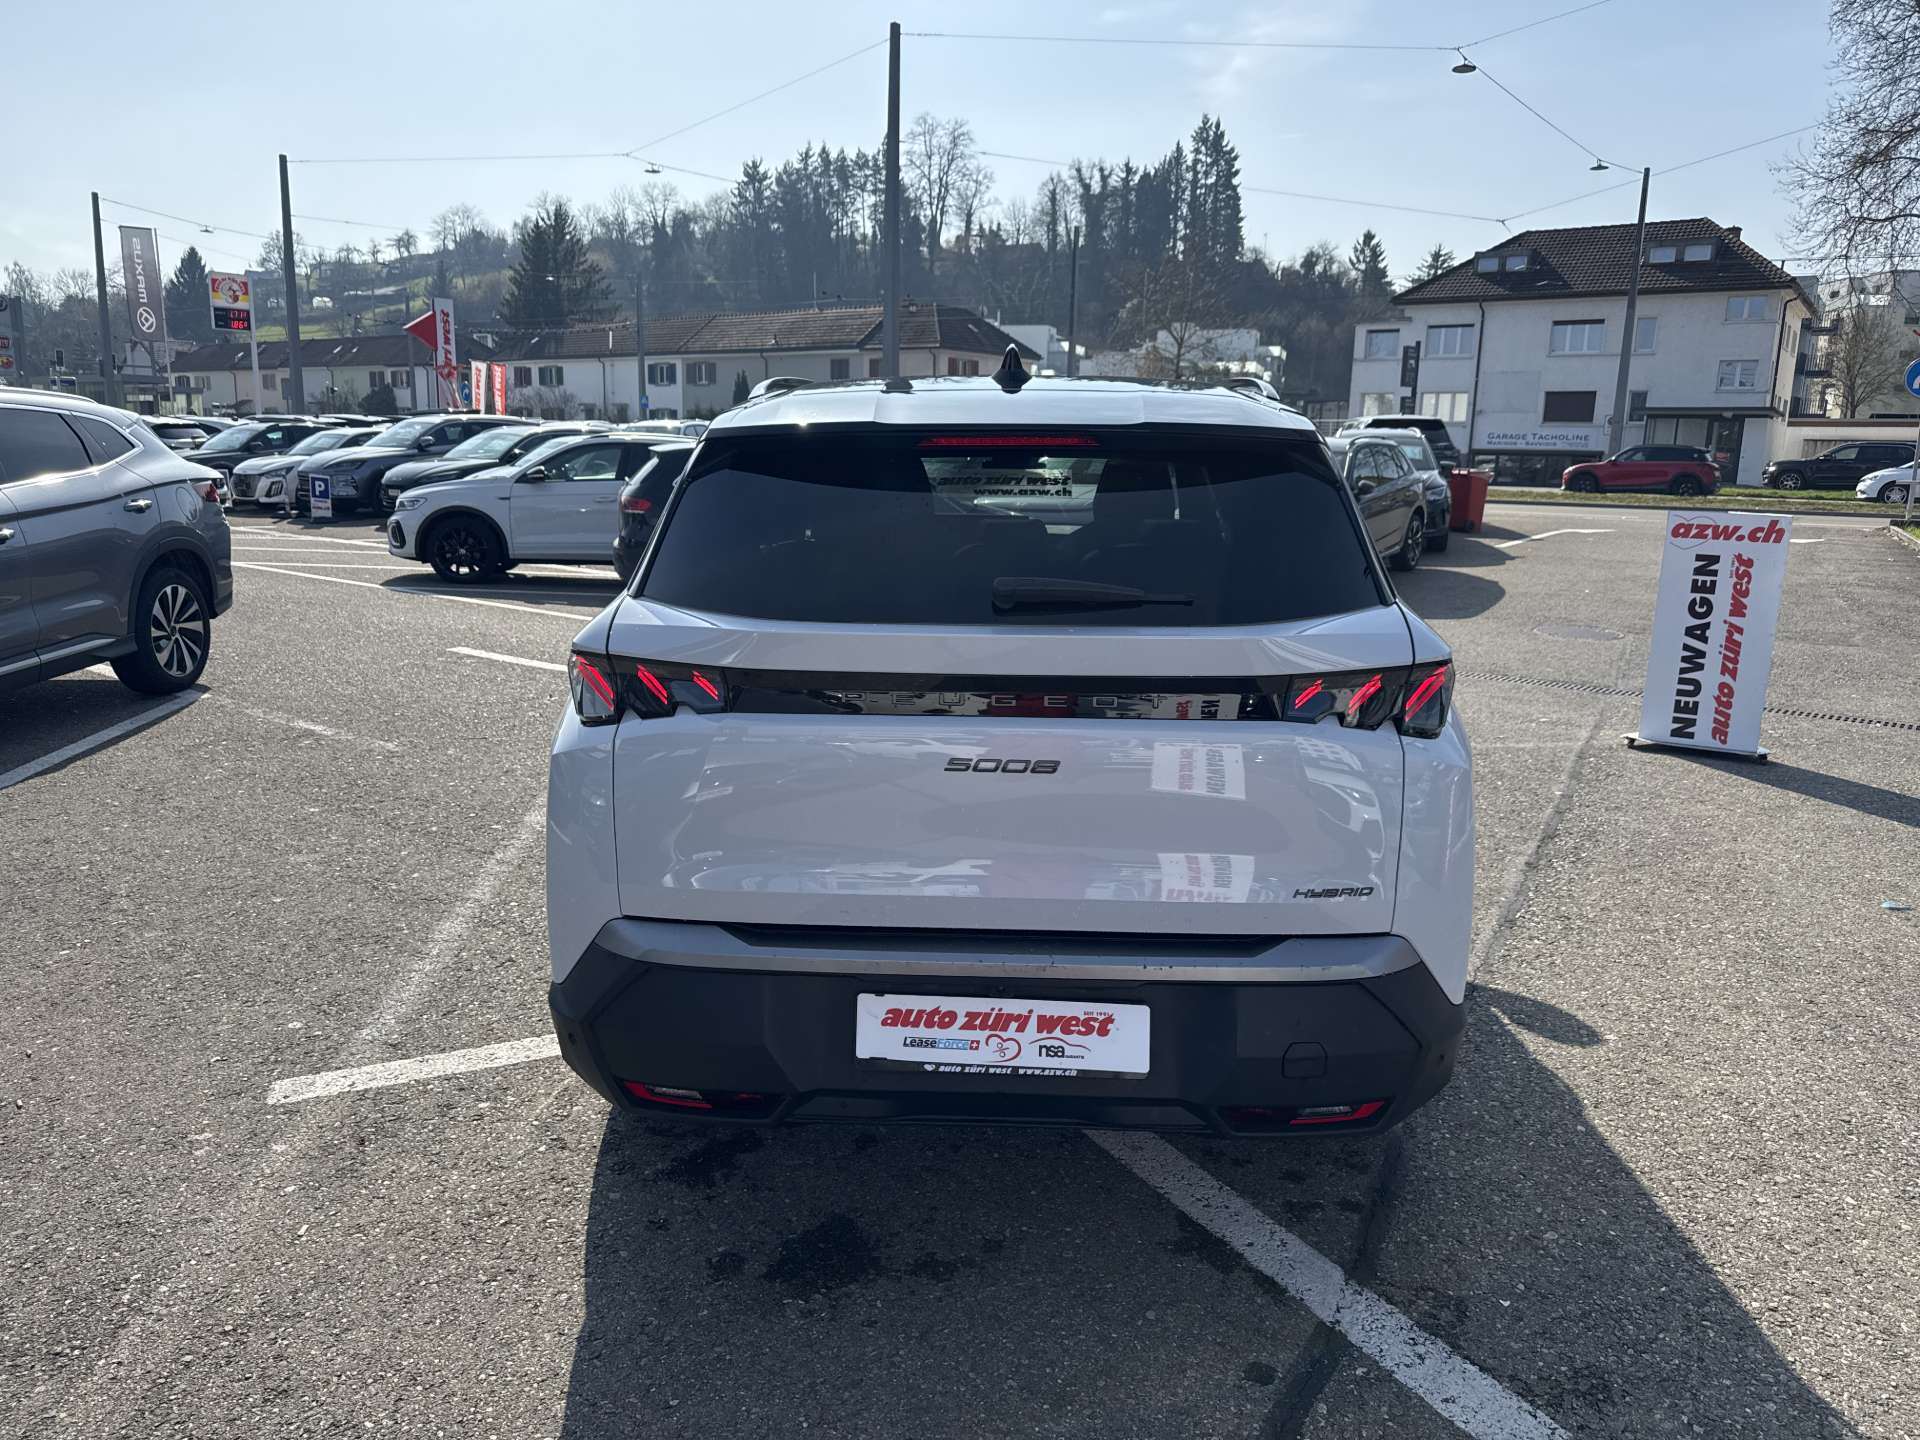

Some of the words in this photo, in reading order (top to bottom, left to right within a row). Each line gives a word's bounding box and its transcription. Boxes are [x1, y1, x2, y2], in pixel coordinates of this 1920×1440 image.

[1671, 520, 1786, 544] azw.ch
[1728, 552, 1755, 618] west
[1670, 553, 1721, 740] NEUWAGEN
[1718, 619, 1745, 682] züri
[1711, 681, 1735, 745] auto
[943, 757, 1061, 775] 5008
[1292, 886, 1375, 899] HYBRID
[880, 1004, 957, 1030] auto
[958, 1007, 1034, 1033] züri
[1036, 1011, 1116, 1037] west
[1038, 1043, 1066, 1058] nsa
[938, 1064, 962, 1073] auto
